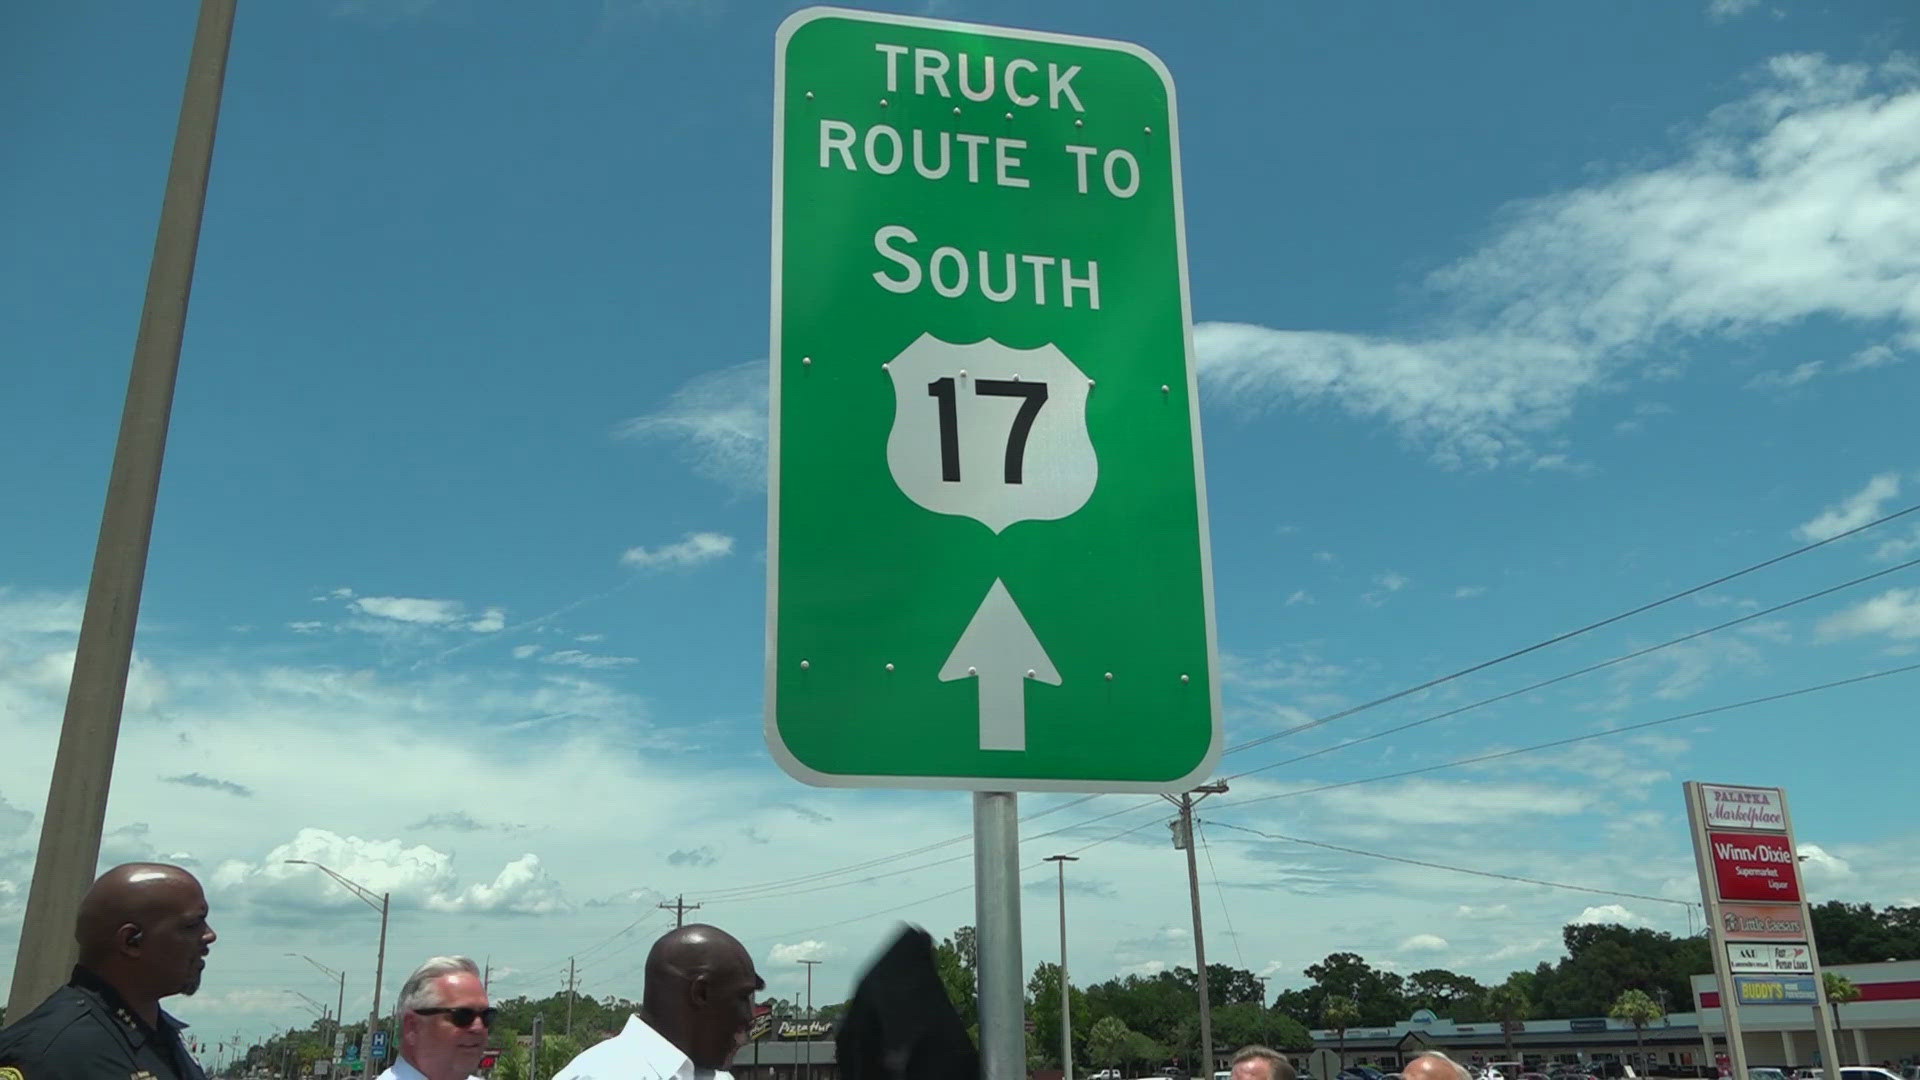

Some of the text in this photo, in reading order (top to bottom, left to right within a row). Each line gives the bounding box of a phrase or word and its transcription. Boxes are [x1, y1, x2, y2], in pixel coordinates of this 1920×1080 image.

[875, 43, 1086, 112] TRUCK
[819, 119, 1141, 199] ROUTE TO
[872, 225, 1101, 310] SOUTH
[927, 377, 1048, 485] 17
[1714, 791, 1770, 805] PALATKA
[1709, 802, 1781, 827] Marketplace
[1735, 865, 1779, 877] Supermarket
[1768, 880, 1789, 890] Liquor
[1740, 916, 1800, 932] Little Caesars
[1741, 982, 1784, 1000] BUDDY'S
[778, 1021, 833, 1034] Pizza Hut
[374, 1034, 384, 1045] H
